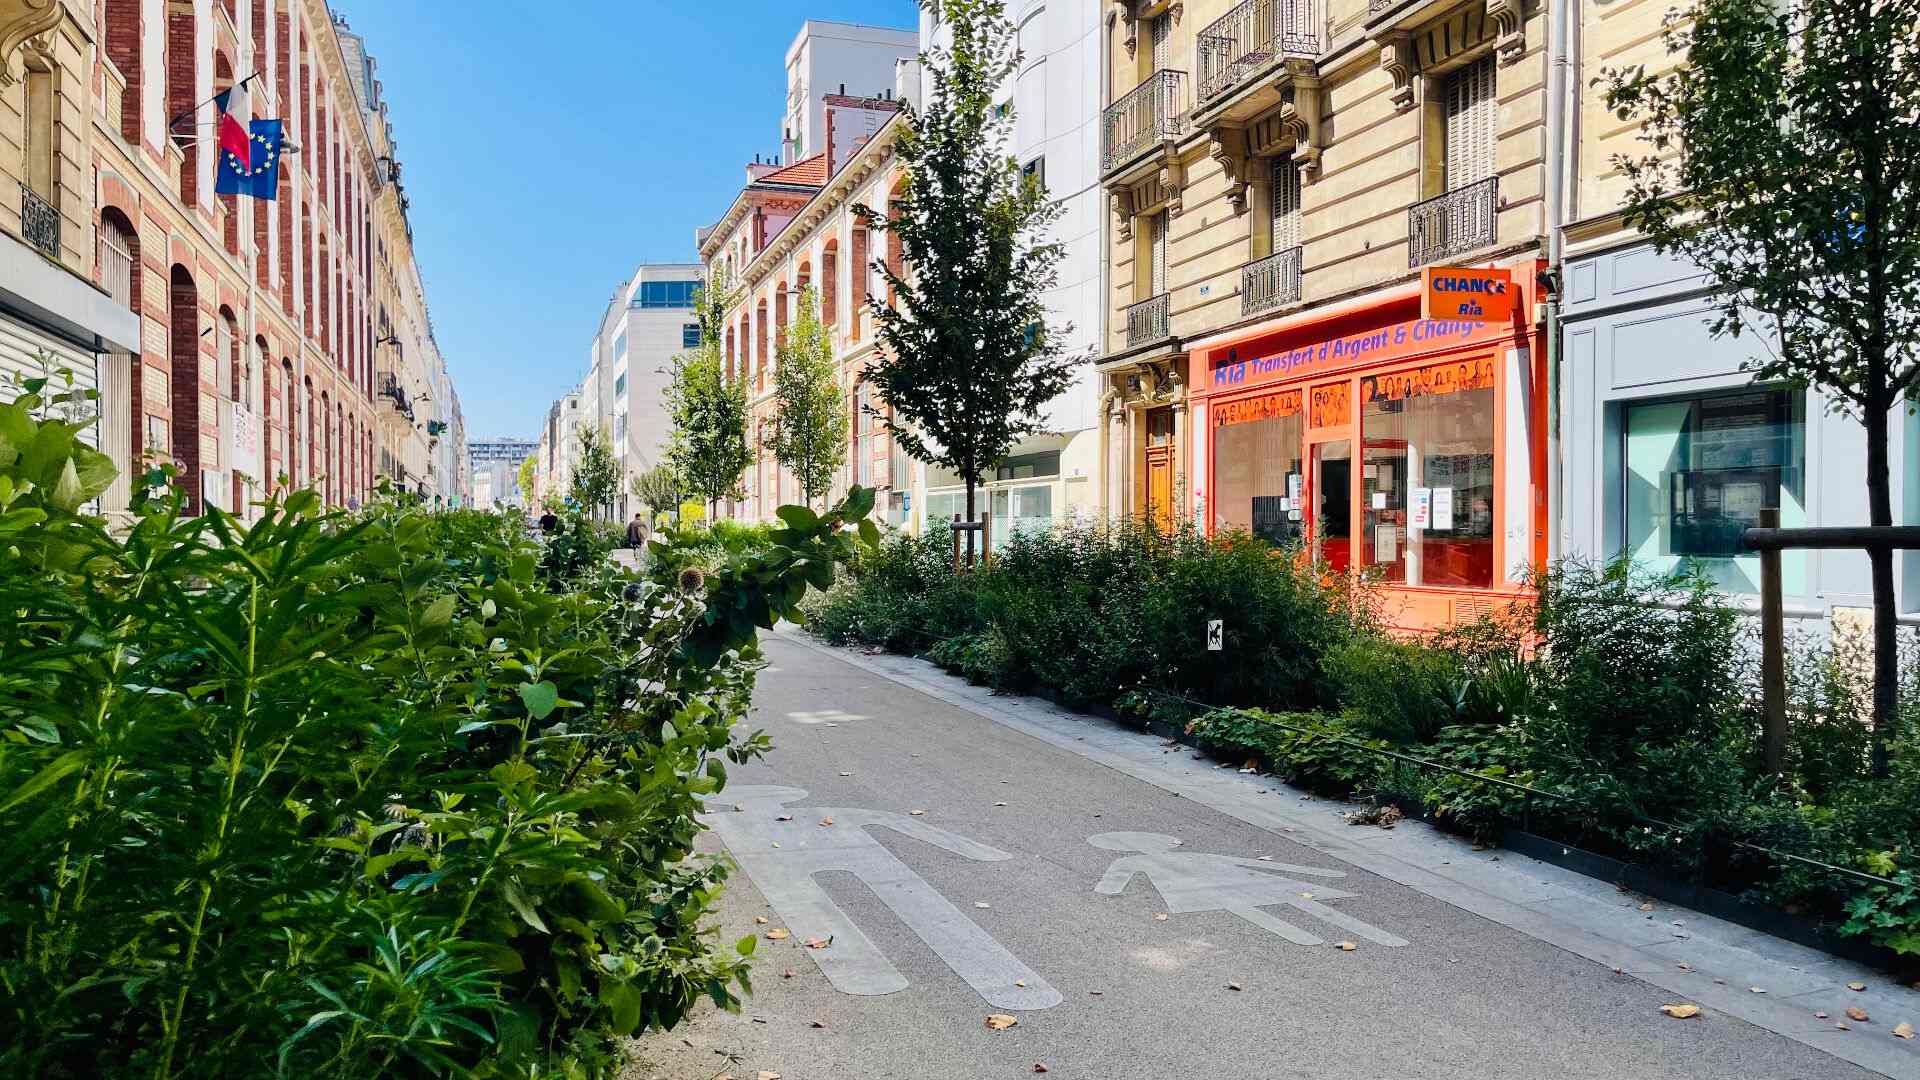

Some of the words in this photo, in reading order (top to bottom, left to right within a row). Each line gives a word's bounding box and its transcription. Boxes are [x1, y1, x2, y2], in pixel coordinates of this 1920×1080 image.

[1458, 299, 1482, 314] Ria
[1215, 347, 1246, 384] Ria
[1252, 346, 1314, 374] Transfert
[1319, 335, 1388, 360] d'Argent
[1394, 325, 1406, 344] &
